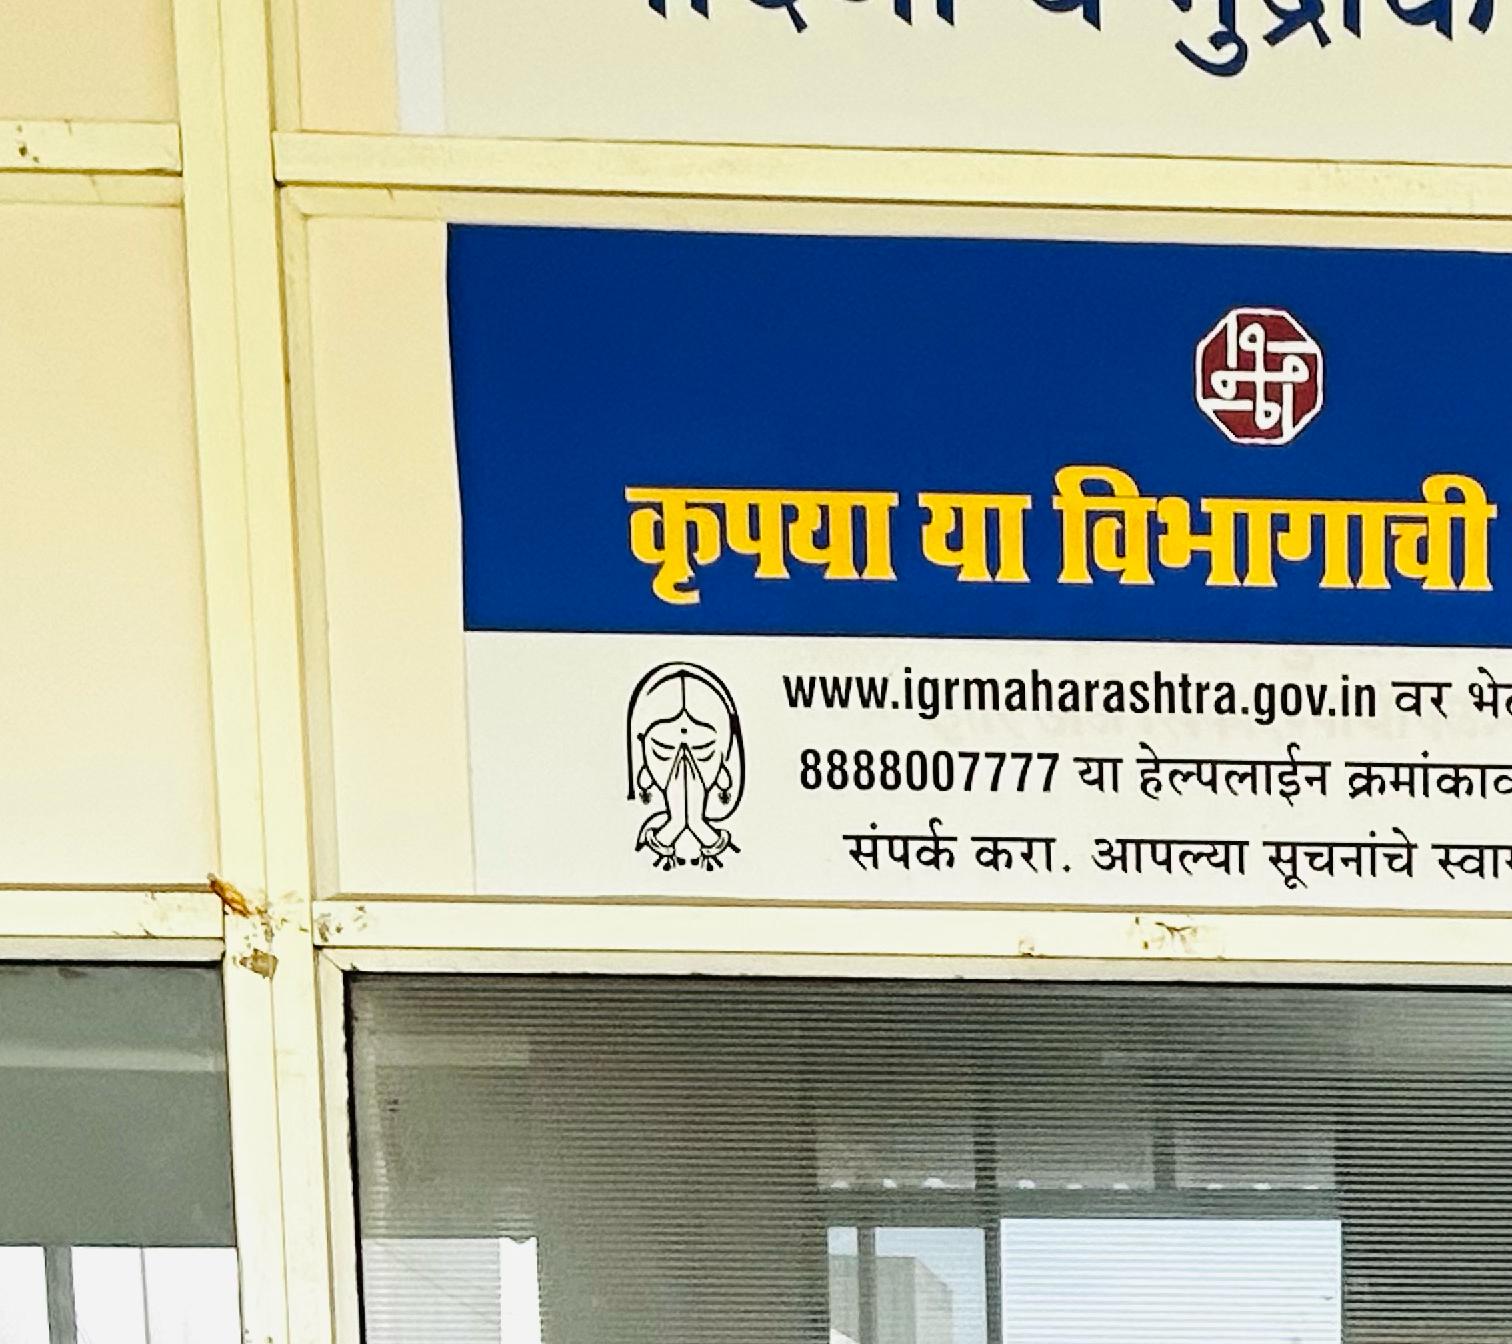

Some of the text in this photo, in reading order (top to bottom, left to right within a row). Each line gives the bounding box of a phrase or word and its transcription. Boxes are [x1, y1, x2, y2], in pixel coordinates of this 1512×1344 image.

[625, 485, 899, 604] कृपया
[919, 492, 1032, 584] या
[1052, 464, 1498, 593] विभागाची
[783, 667, 1376, 726] www.igrmaharashtra.gov.in
[1391, 680, 1452, 719] वर
[799, 748, 1060, 792] 8888007777
[1072, 756, 1123, 794] या
[1136, 743, 1332, 806] हेल्पलाईन
[842, 817, 958, 871] संपर्क
[1091, 838, 1250, 875] आपल्या
[1263, 827, 1418, 890] सूचनांचे
